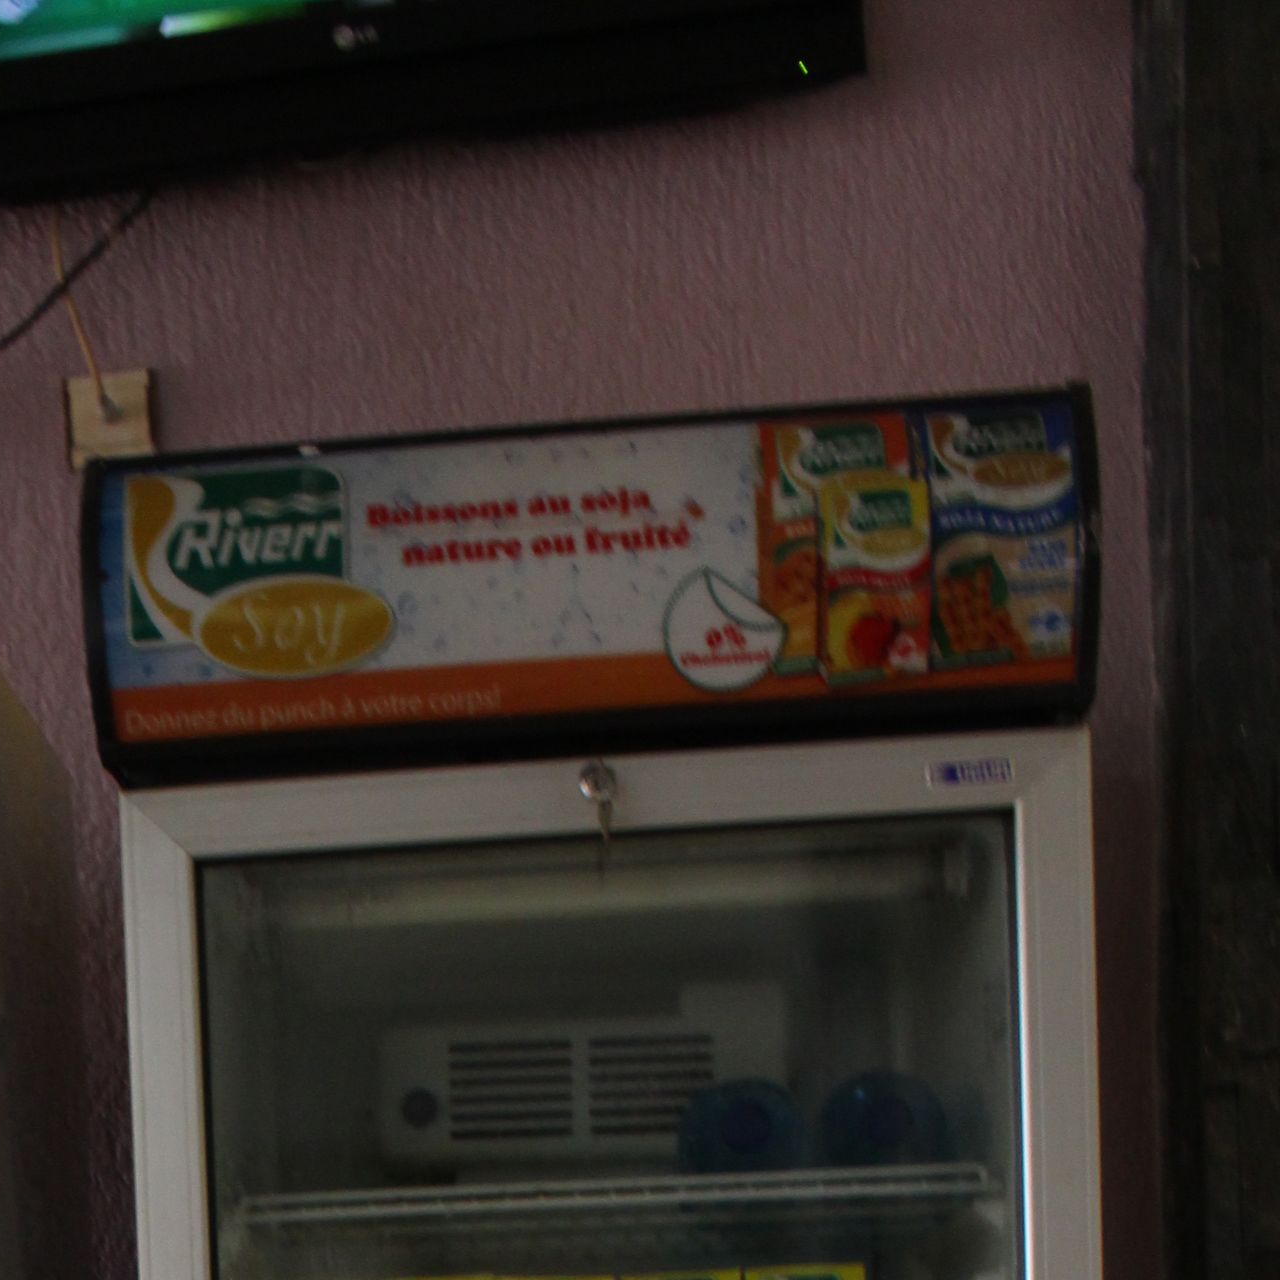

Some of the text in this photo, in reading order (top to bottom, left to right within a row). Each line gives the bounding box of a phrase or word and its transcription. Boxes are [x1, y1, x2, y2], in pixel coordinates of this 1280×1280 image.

[366, 485, 650, 528] Boissons au soja
[175, 507, 342, 570] Riverr
[401, 520, 691, 567] nature ou fruité
[234, 598, 347, 668] Soy
[704, 625, 747, 651] 0%
[261, 697, 338, 733] punch
